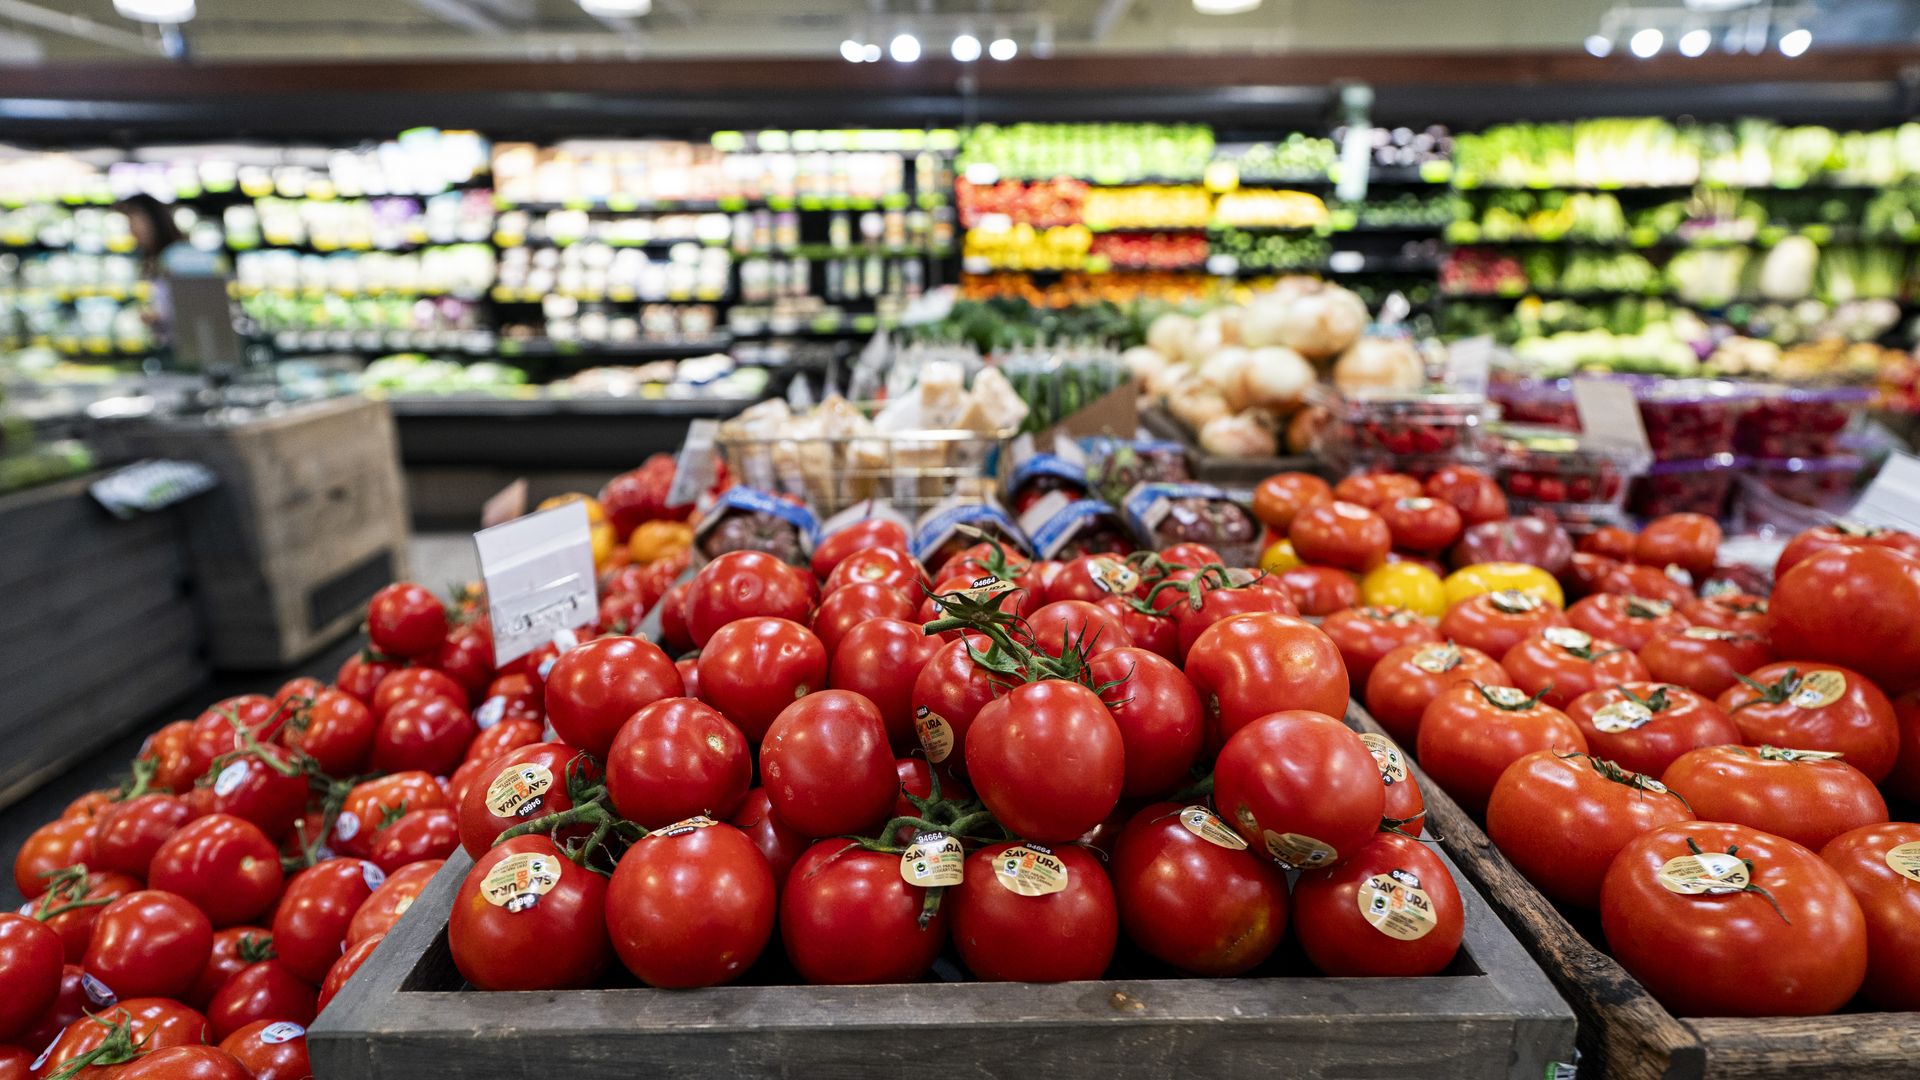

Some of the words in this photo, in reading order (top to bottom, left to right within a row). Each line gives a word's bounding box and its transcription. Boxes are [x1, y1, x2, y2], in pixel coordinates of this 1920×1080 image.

[497, 778, 549, 813] SAVOURA
[1005, 850, 1061, 874] SAVOURA
[490, 874, 552, 898] SAVOURA
[1371, 878, 1429, 912] SAVOURA
